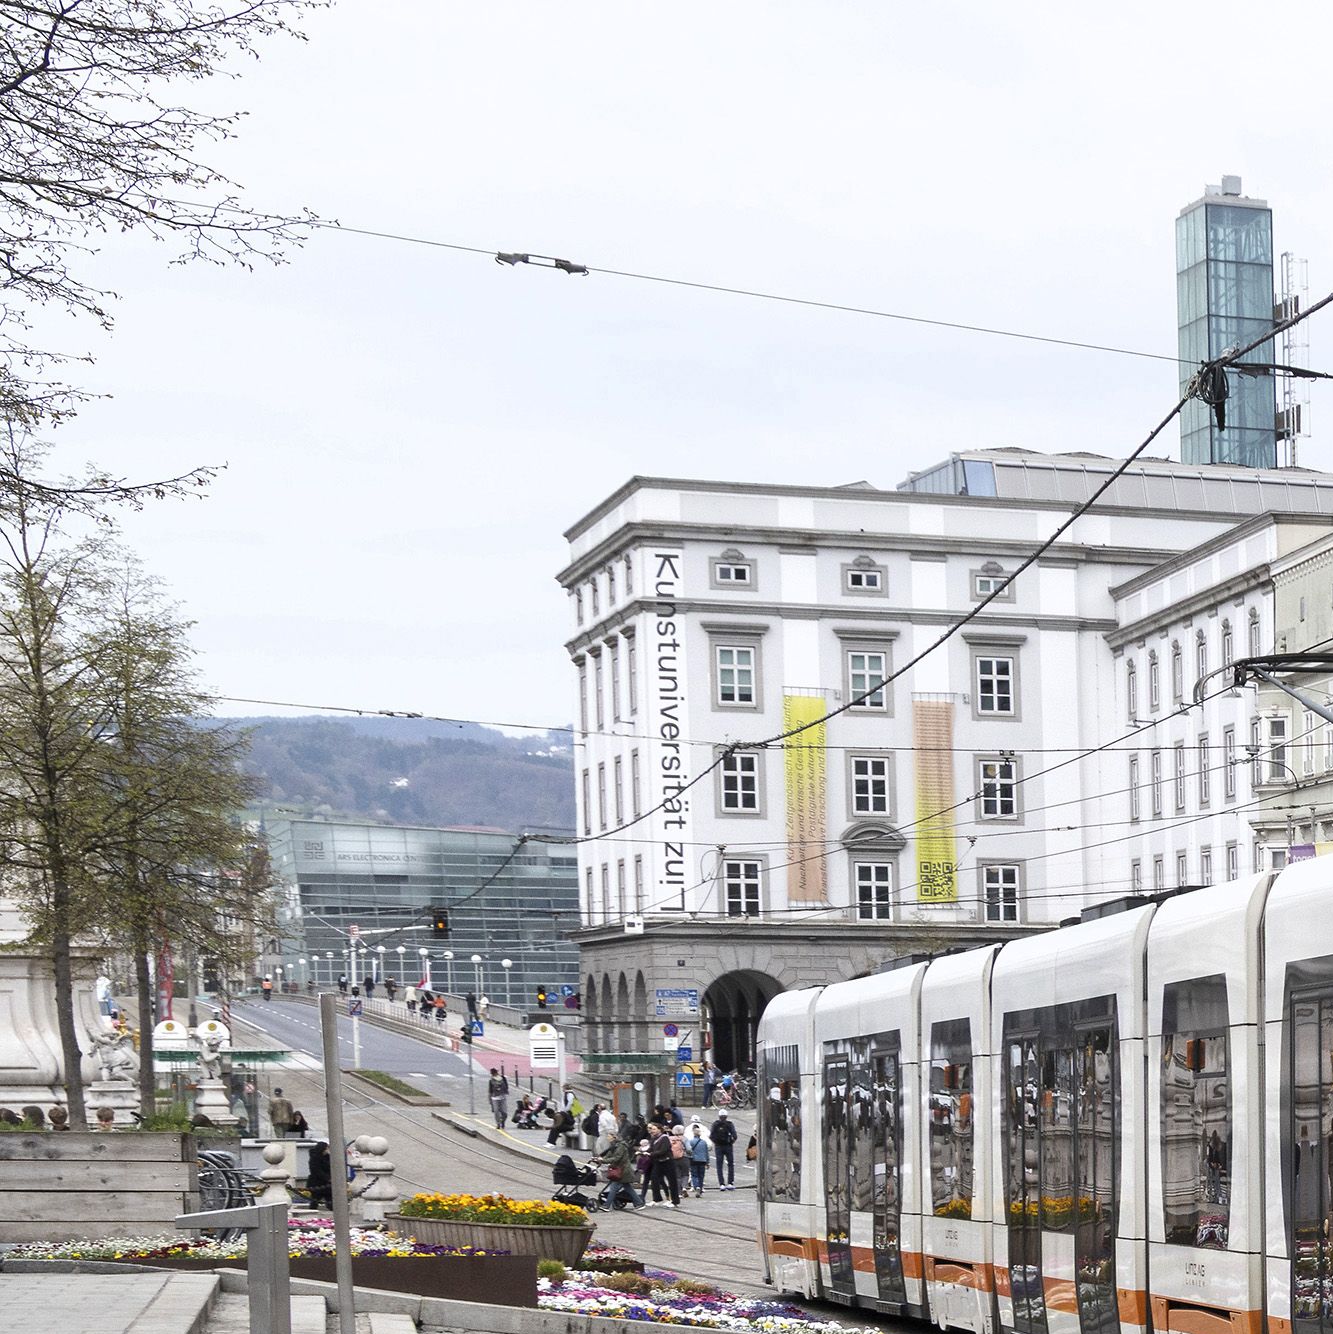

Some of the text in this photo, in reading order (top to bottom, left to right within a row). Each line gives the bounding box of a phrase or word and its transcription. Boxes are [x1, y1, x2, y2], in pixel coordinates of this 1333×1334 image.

[654, 553, 687, 830] Kunstuniversität
[817, 756, 825, 774] und
[795, 773, 804, 813] kritische
[808, 783, 817, 837] Postdigitale
[817, 777, 827, 826] Forschung
